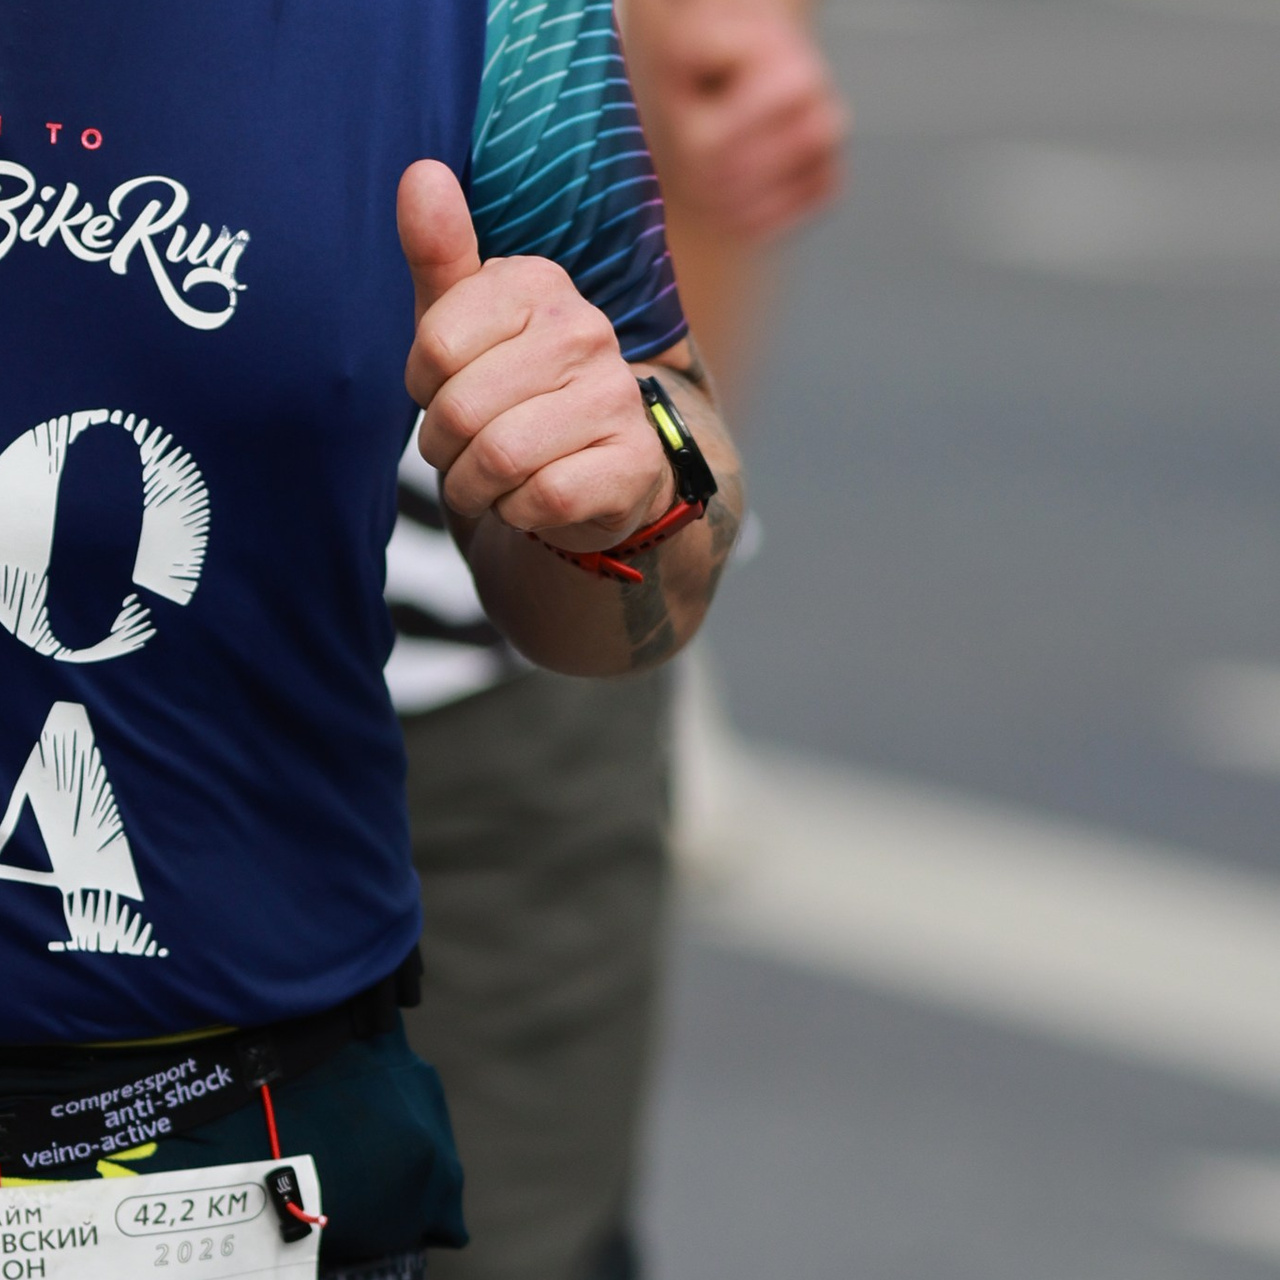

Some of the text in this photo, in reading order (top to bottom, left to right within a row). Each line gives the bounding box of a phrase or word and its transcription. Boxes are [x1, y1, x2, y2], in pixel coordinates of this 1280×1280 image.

[45, 122, 103, 150] TO
[50, 1057, 198, 1119] compressport
[102, 1063, 234, 1130] anti-shock
[22, 1115, 173, 1170] veino-active
[133, 1199, 195, 1228] 42,2
[153, 1234, 236, 1267] 2026
